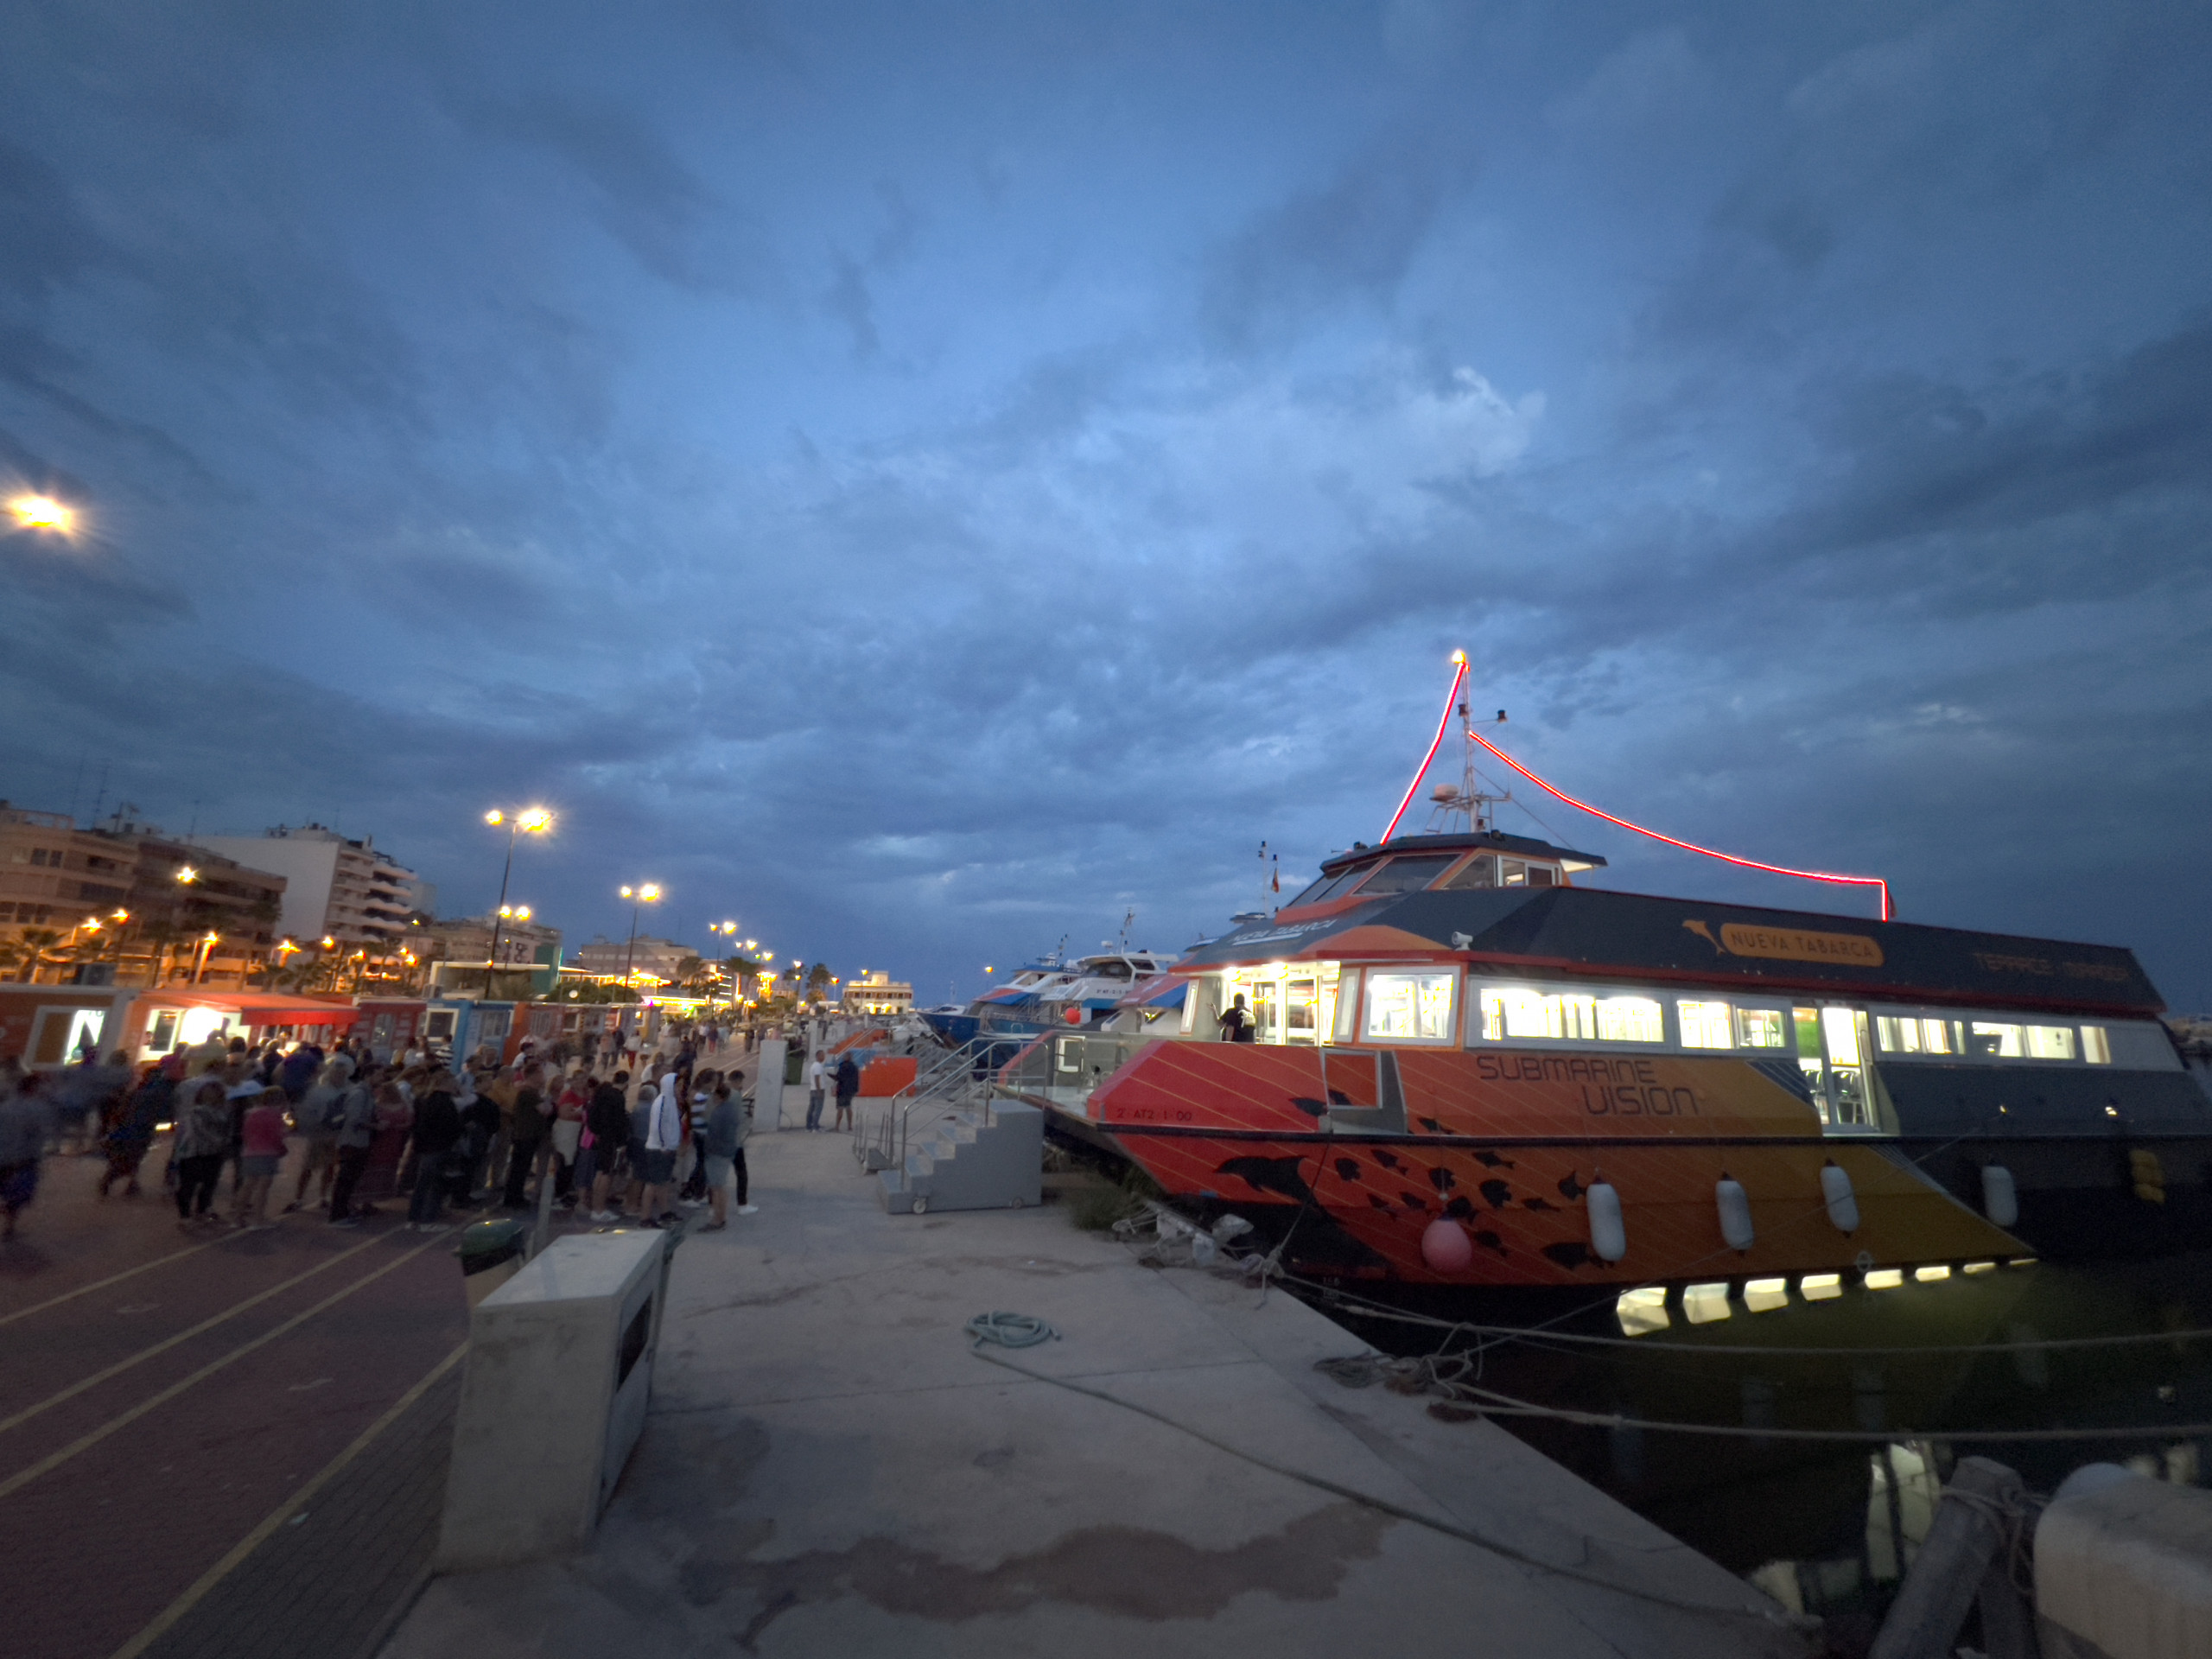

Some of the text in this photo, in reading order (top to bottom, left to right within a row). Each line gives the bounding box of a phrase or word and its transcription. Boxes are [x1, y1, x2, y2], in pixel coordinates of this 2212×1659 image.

[1730, 931, 1875, 958] NUEVA TABARCA
[1477, 1055, 1657, 1084] SUBMARINE
